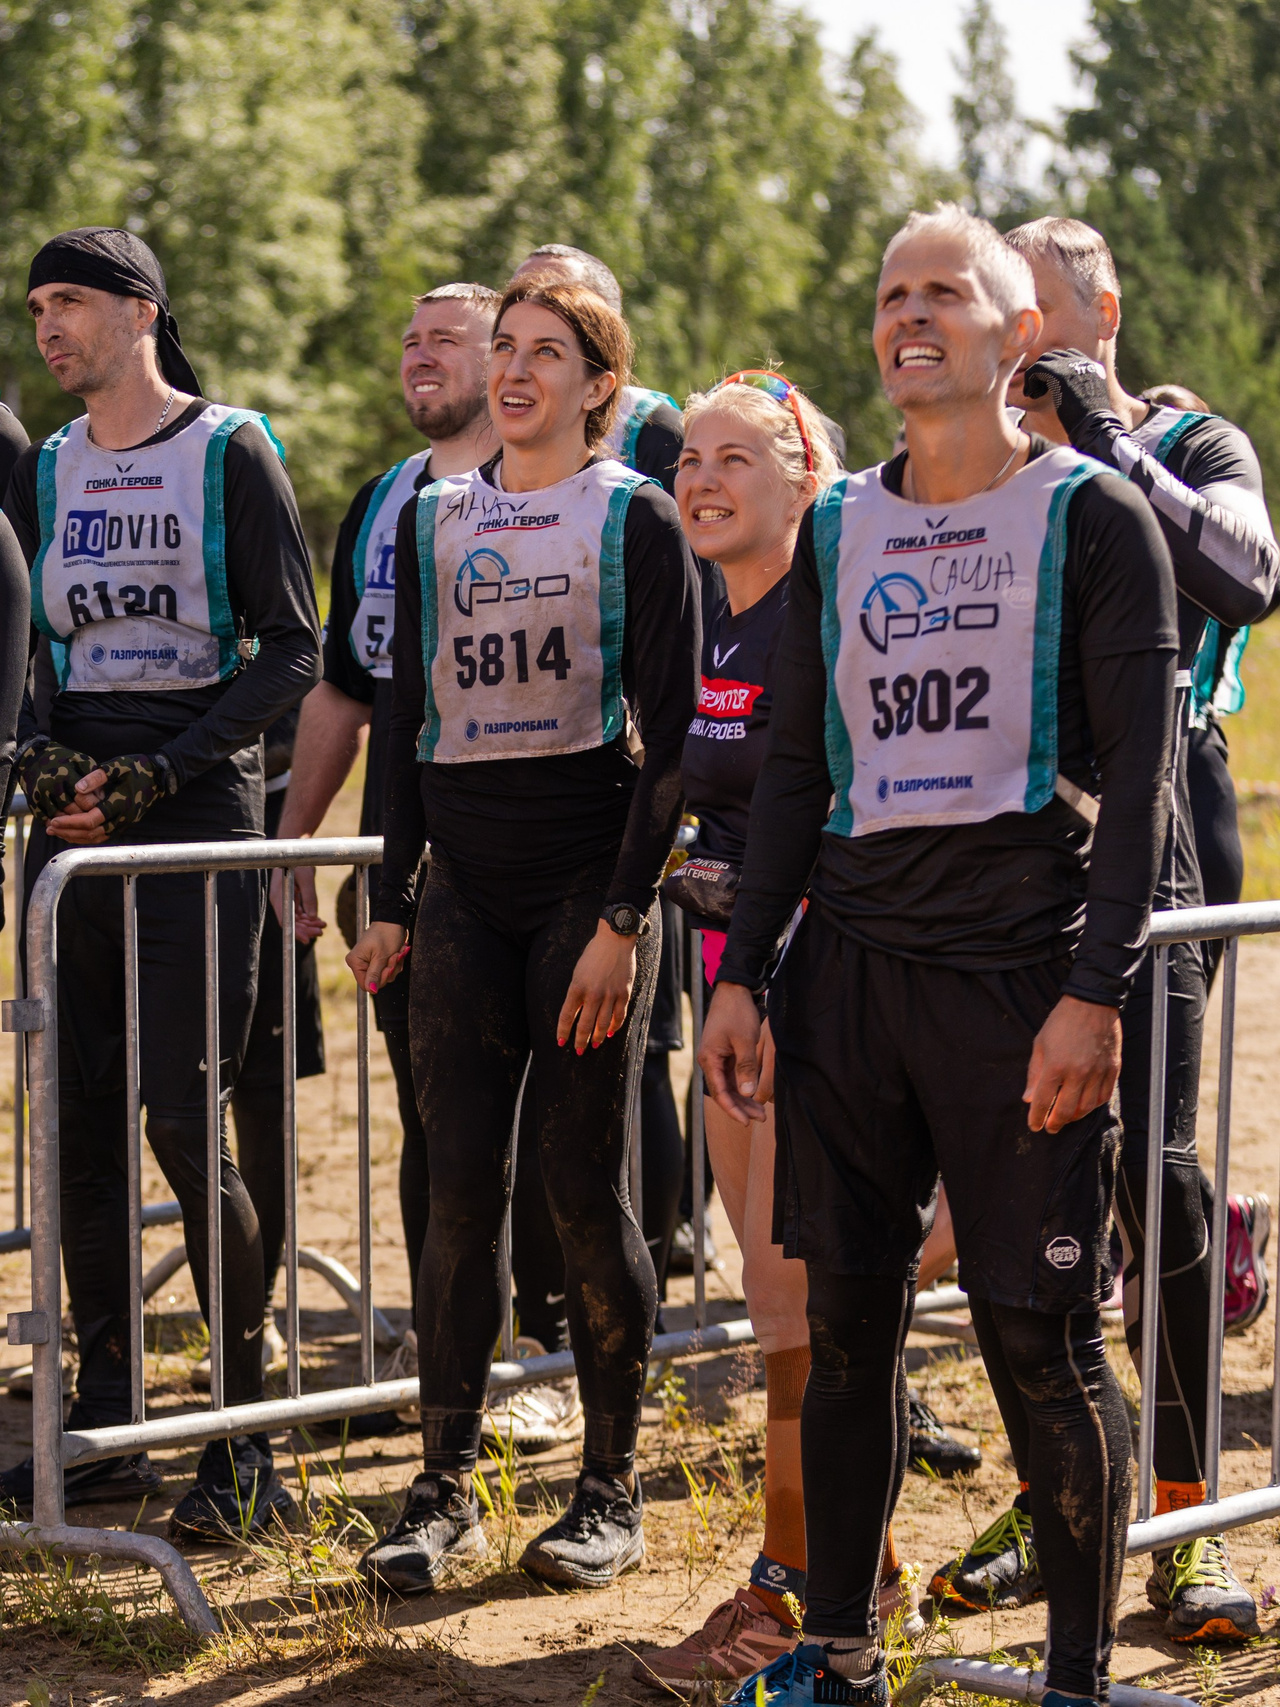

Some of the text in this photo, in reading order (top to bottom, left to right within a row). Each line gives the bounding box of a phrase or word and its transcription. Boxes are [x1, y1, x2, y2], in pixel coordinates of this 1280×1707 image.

[86, 475, 163, 490] ГОНКА ГЕРОЕВ
[477, 513, 560, 532] ГОНКА ГЕРОЕВ
[67, 513, 181, 552] RODVIG
[886, 527, 987, 551] ГОНКА ГЕРОЕВ
[67, 581, 177, 627] 6120
[110, 648, 179, 661] ГАЗПРОМБАНК
[453, 626, 571, 690] 5814
[869, 666, 990, 740] 5802
[484, 718, 558, 735] ГАЗПРОМБАНК
[893, 775, 974, 794] ГАЗПРОМБАНК
[687, 868, 721, 882] ГЕРОЕВ
